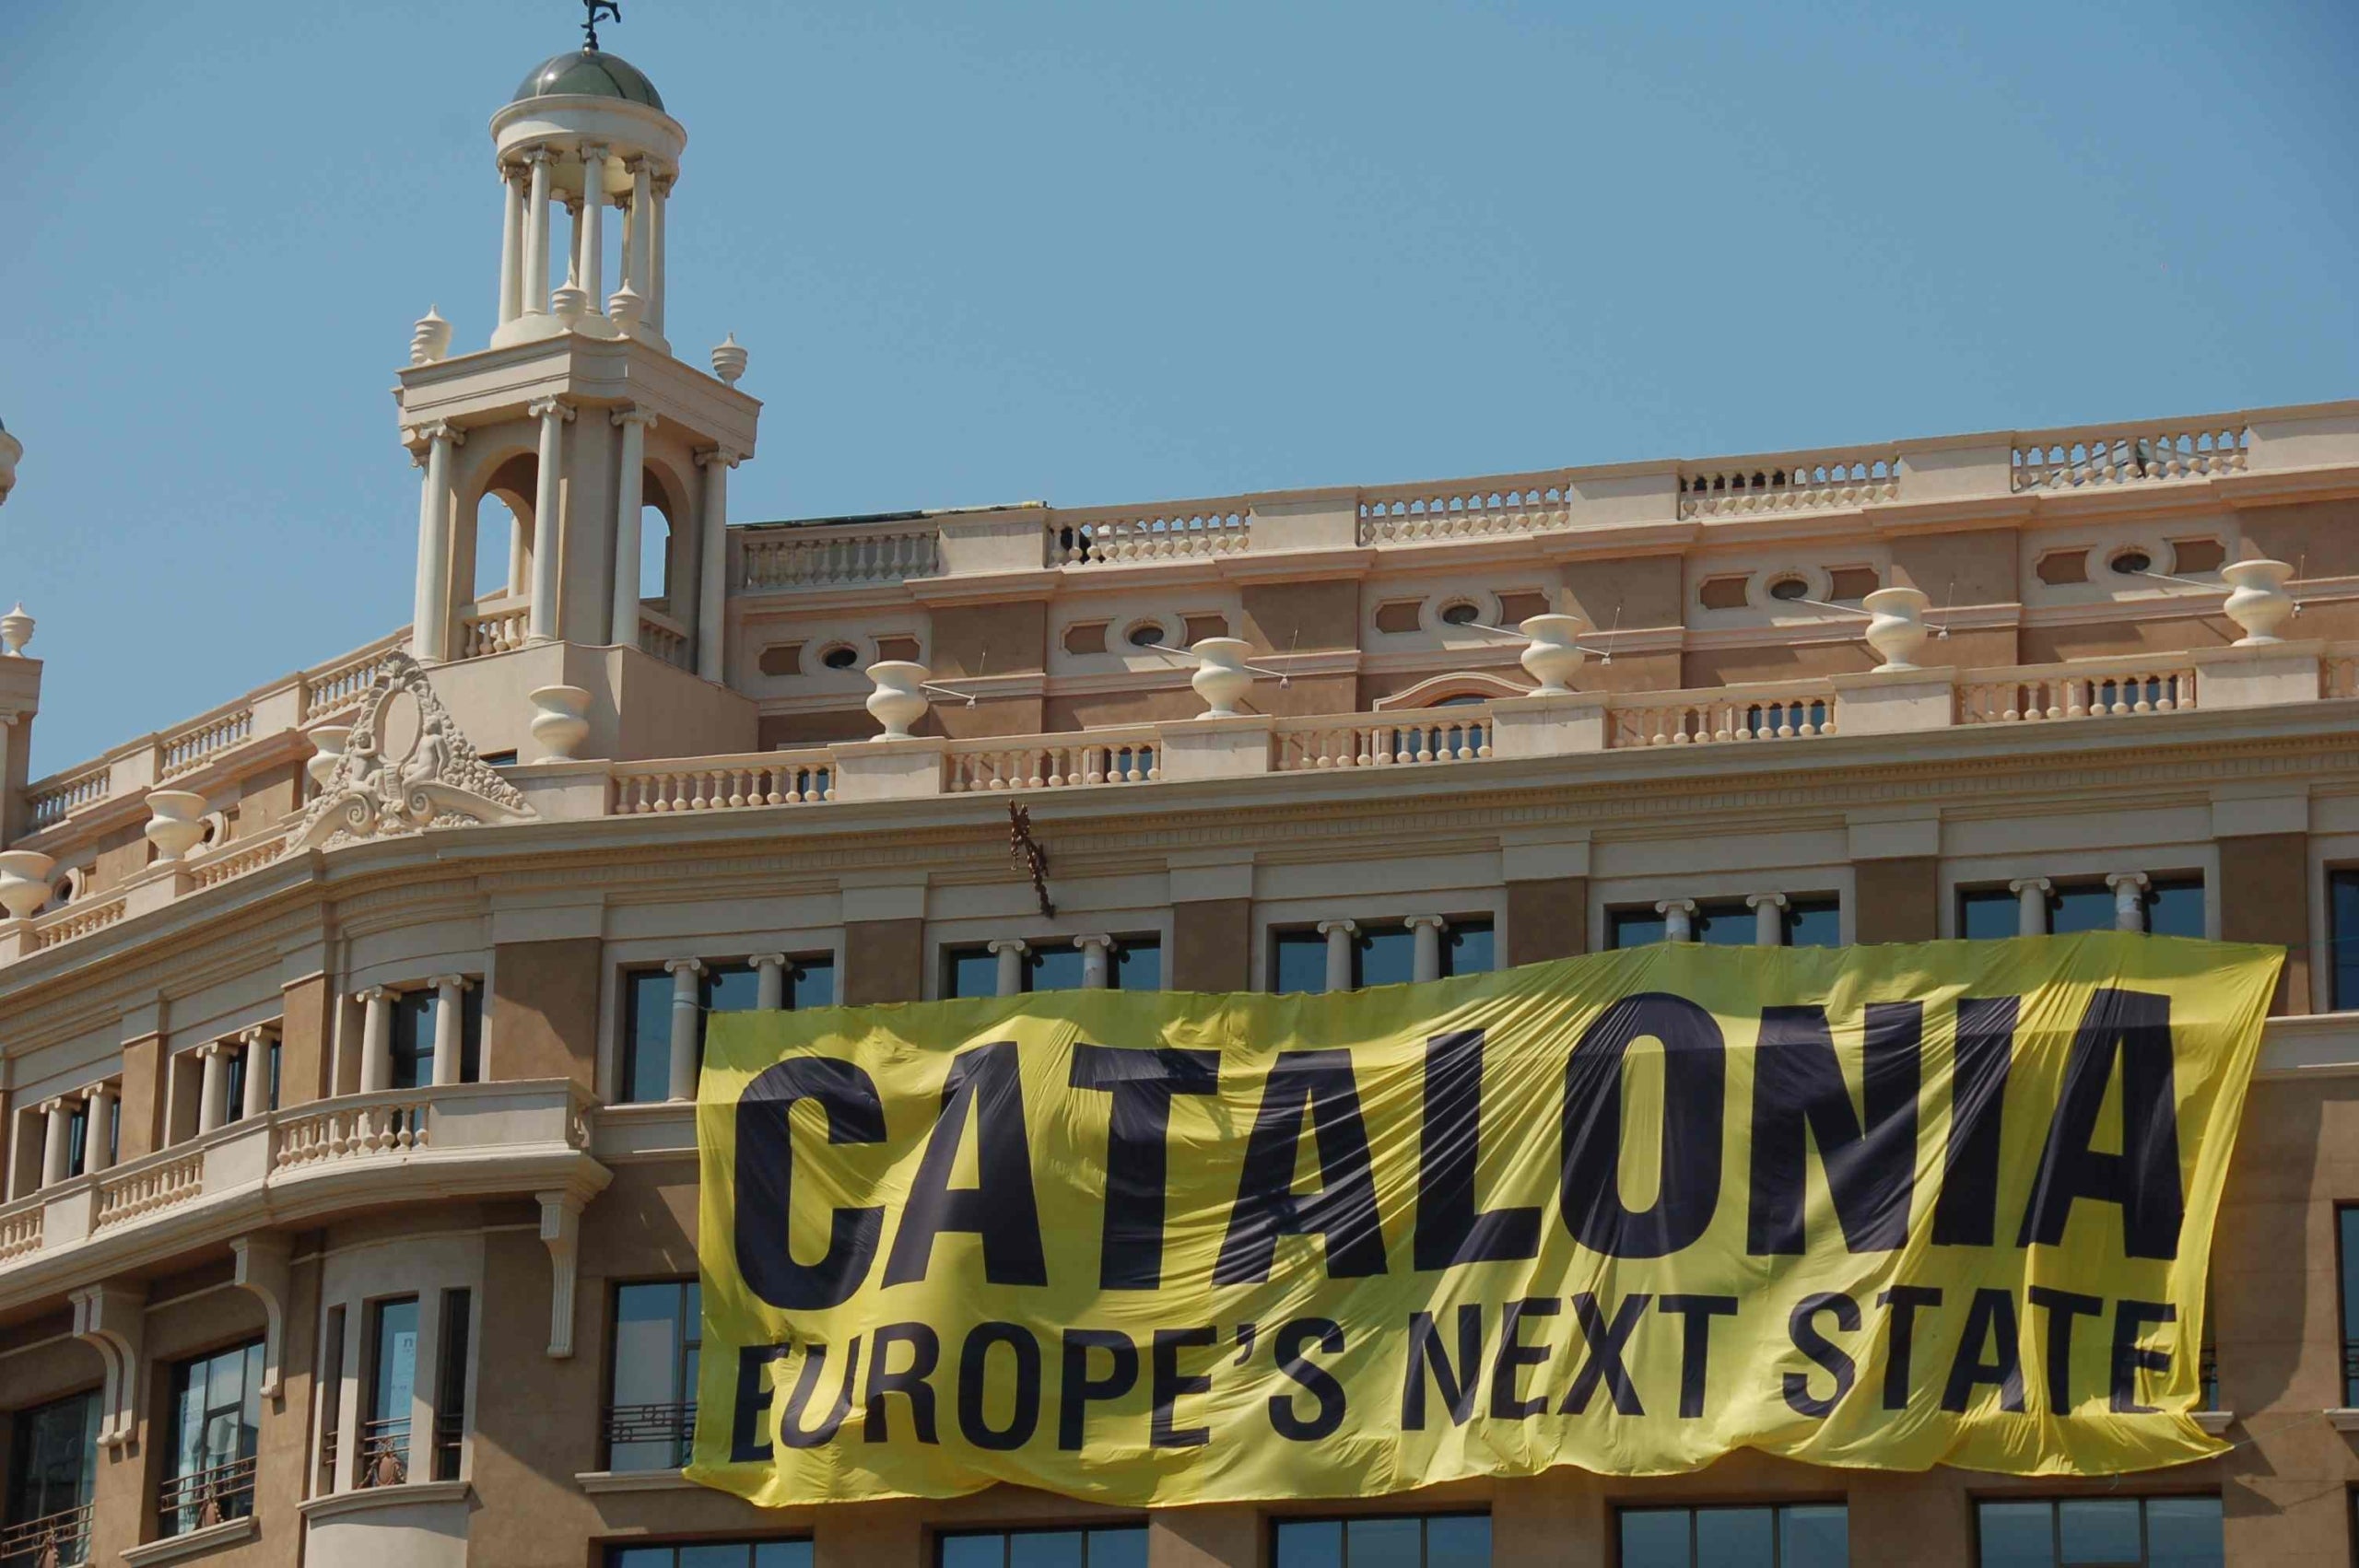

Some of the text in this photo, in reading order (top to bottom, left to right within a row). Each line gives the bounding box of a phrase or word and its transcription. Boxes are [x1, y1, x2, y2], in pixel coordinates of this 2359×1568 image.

[734, 989, 2183, 1310] CATALONIA
[729, 1285, 2177, 1463] EUROPE'S NEXT STATE
